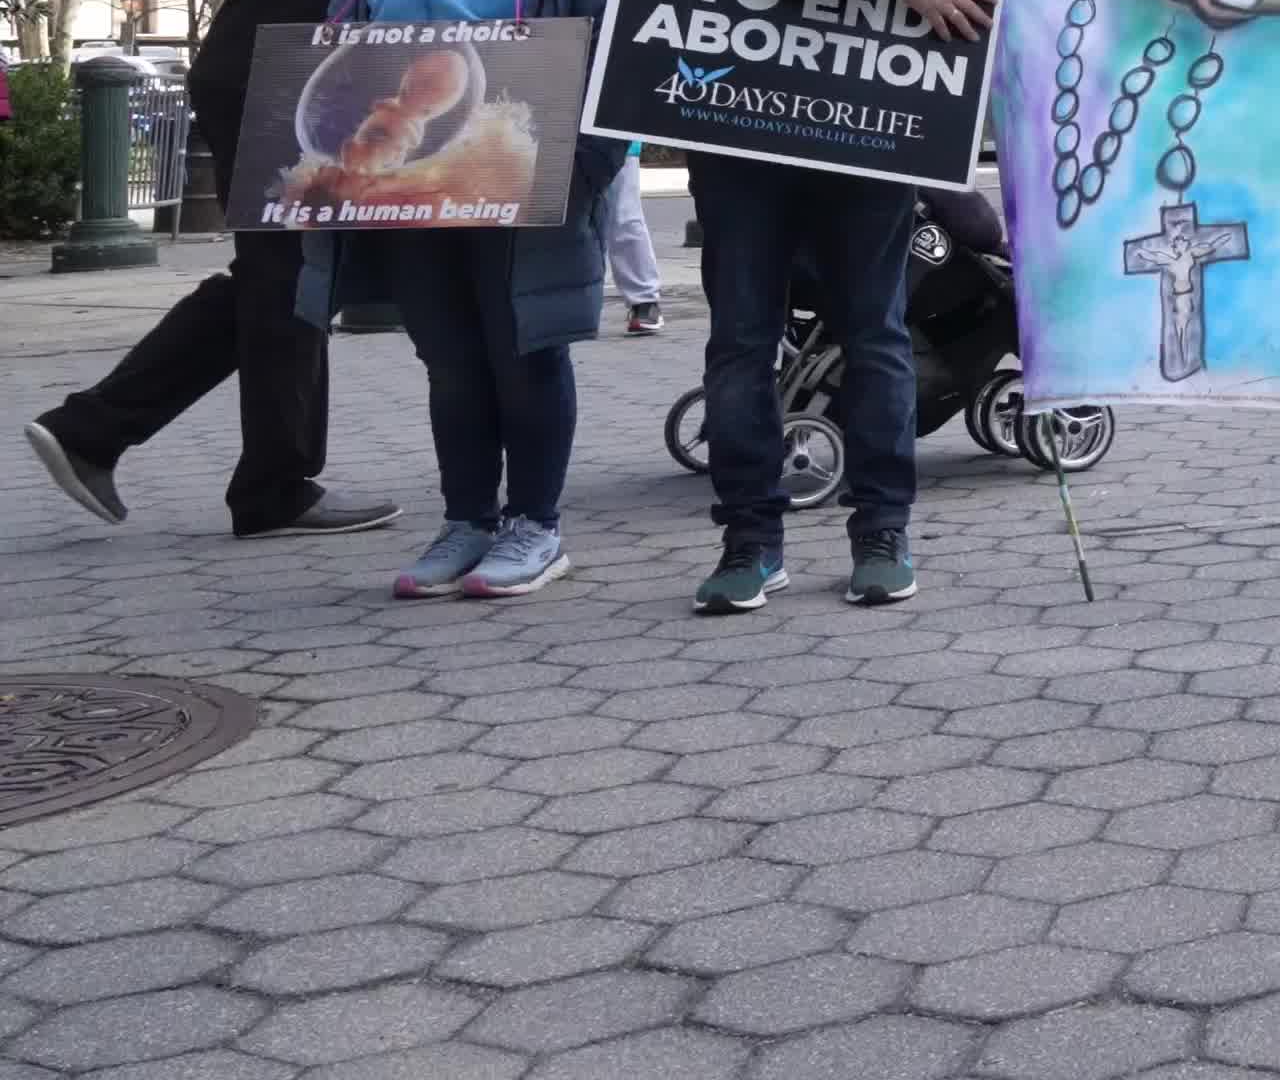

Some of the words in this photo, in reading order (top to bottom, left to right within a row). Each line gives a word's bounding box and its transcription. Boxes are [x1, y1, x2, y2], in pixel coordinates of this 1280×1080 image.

[338, 24, 363, 45] is
[367, 24, 413, 45] not
[419, 26, 436, 43] a
[441, 20, 530, 42] choice
[632, 3, 968, 97] ABORTION
[654, 71, 707, 104] 40
[709, 81, 787, 117] DAYS
[791, 94, 855, 129] FOR
[855, 106, 924, 140] LIFE
[261, 201, 282, 223] It
[288, 201, 313, 223] is
[316, 205, 331, 223] a
[337, 199, 433, 223] human
[439, 198, 521, 224] being
